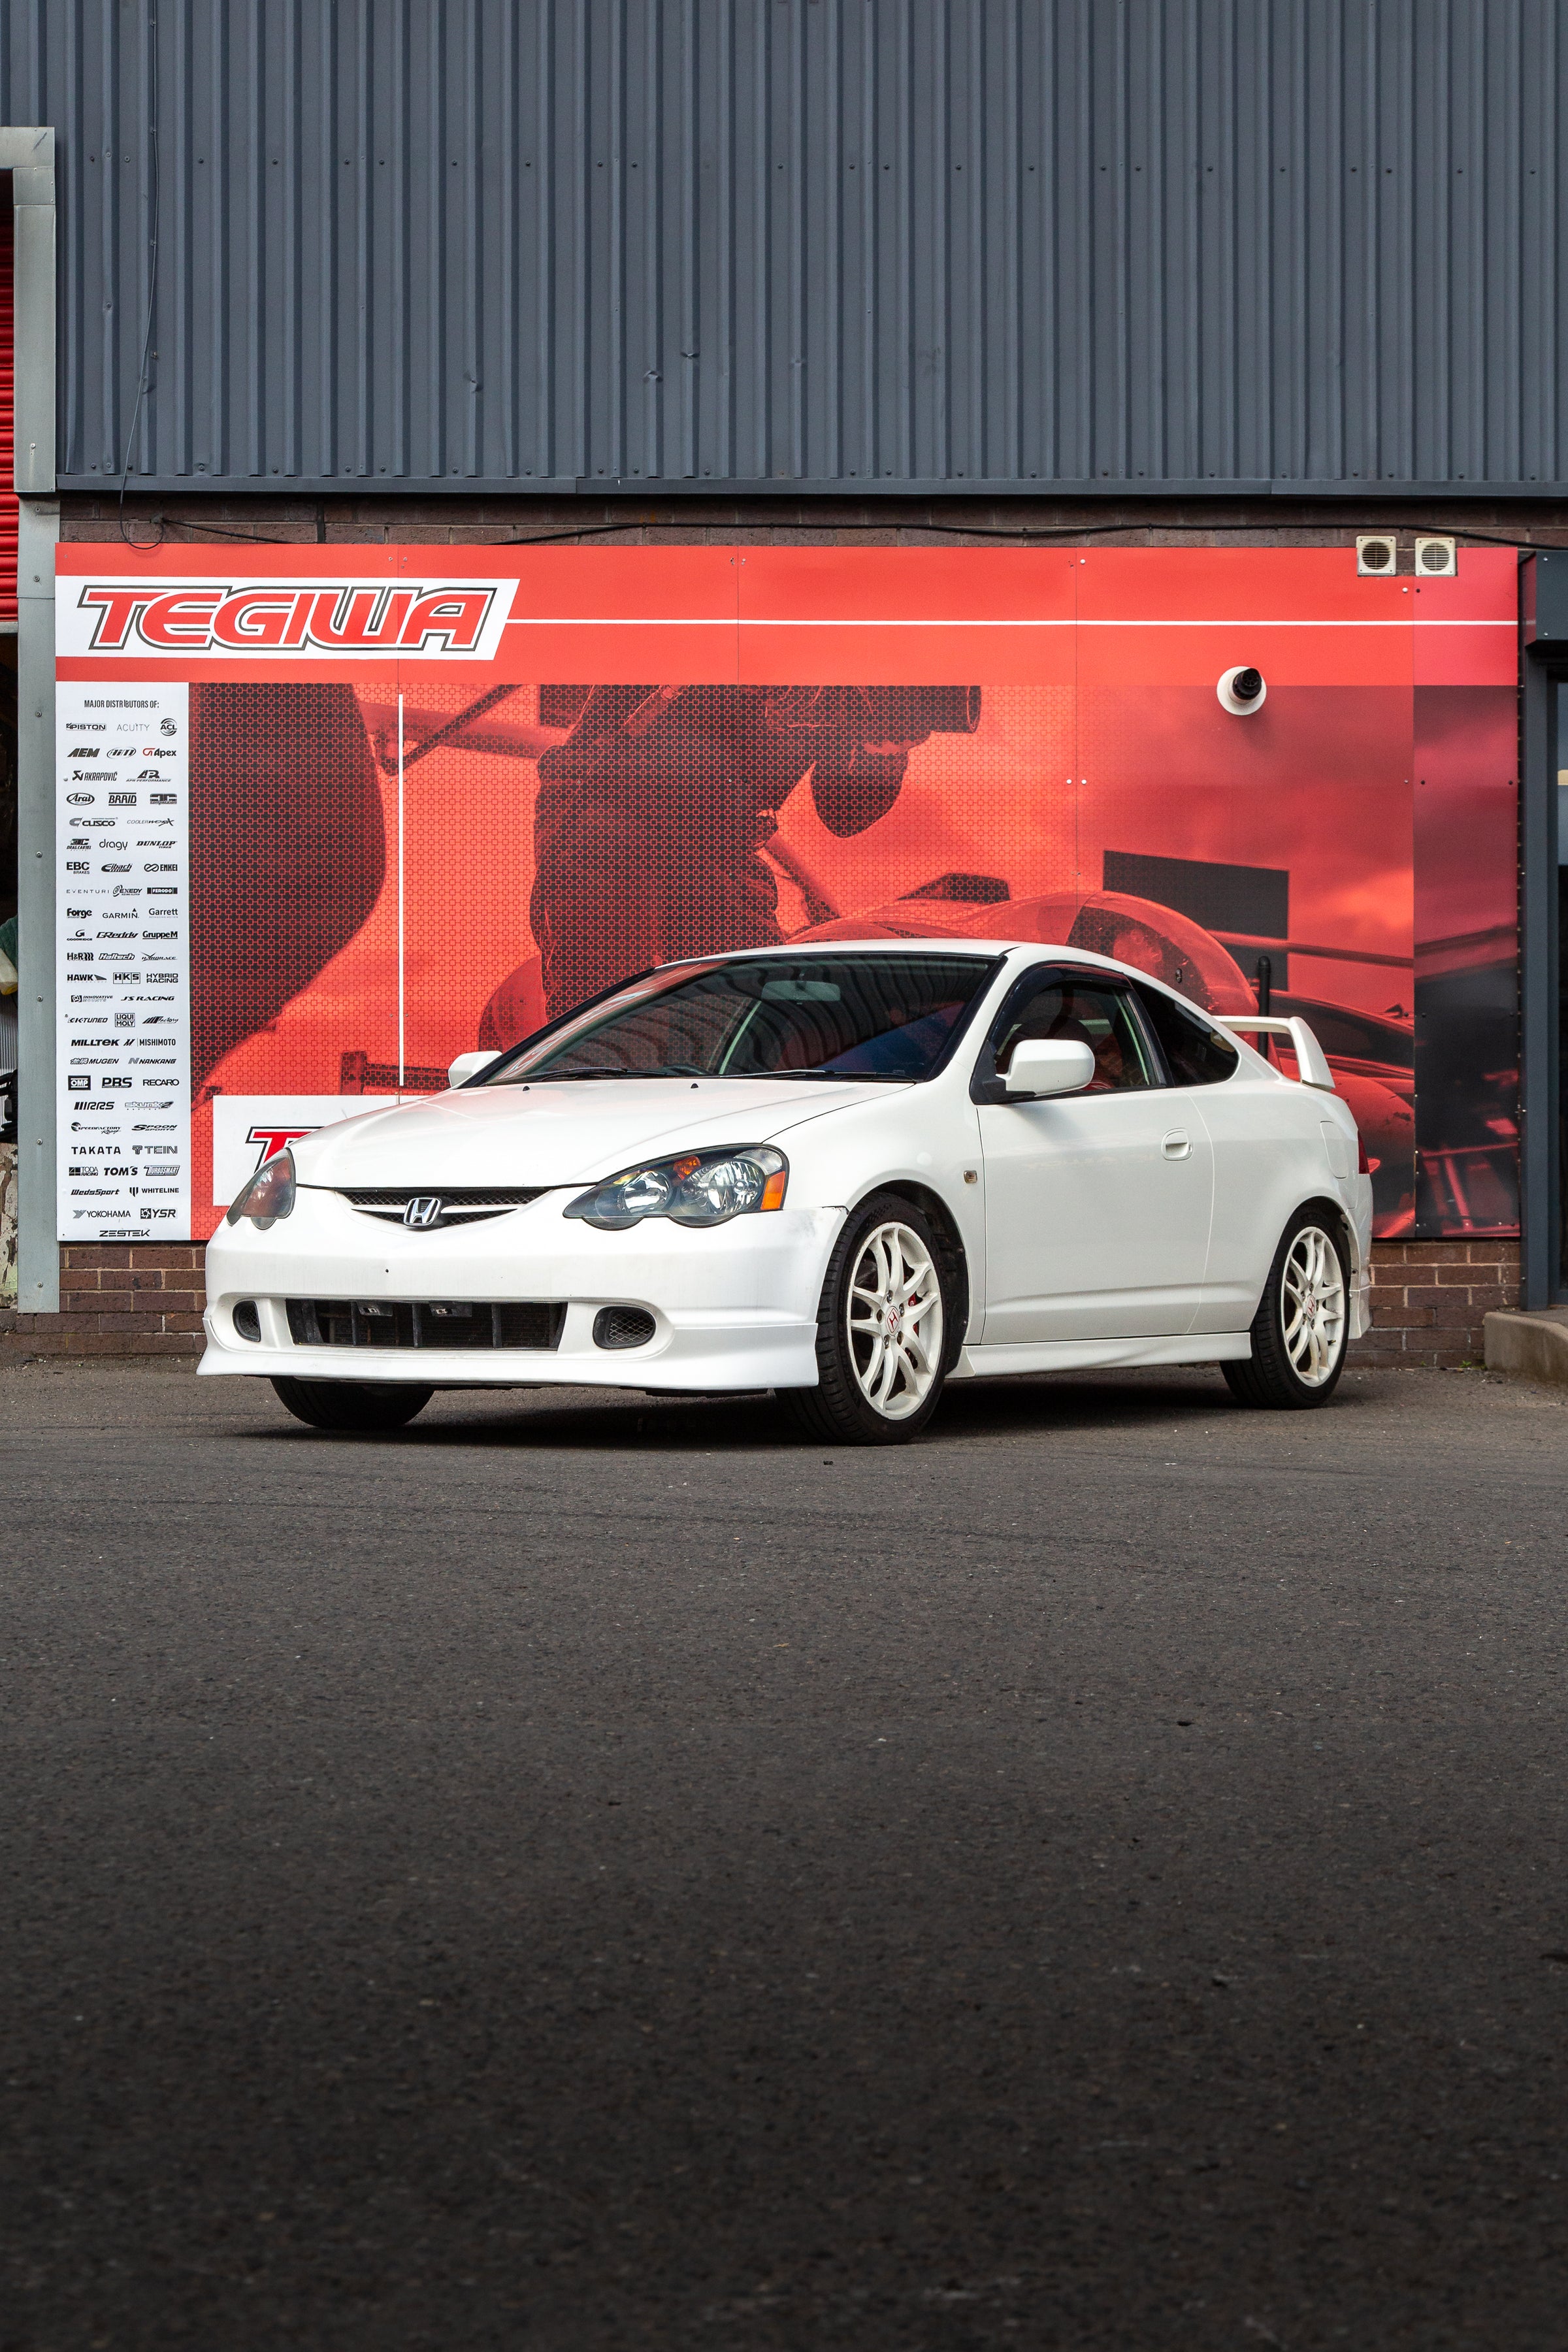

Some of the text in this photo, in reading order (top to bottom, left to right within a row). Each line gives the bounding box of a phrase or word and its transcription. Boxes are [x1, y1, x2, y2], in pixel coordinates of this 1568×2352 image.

[77, 585, 497, 651] TEGIWA
[67, 748, 100, 757] AEM
[99, 839, 128, 850] dragy
[67, 862, 90, 870] EBC
[67, 908, 92, 919] Forge
